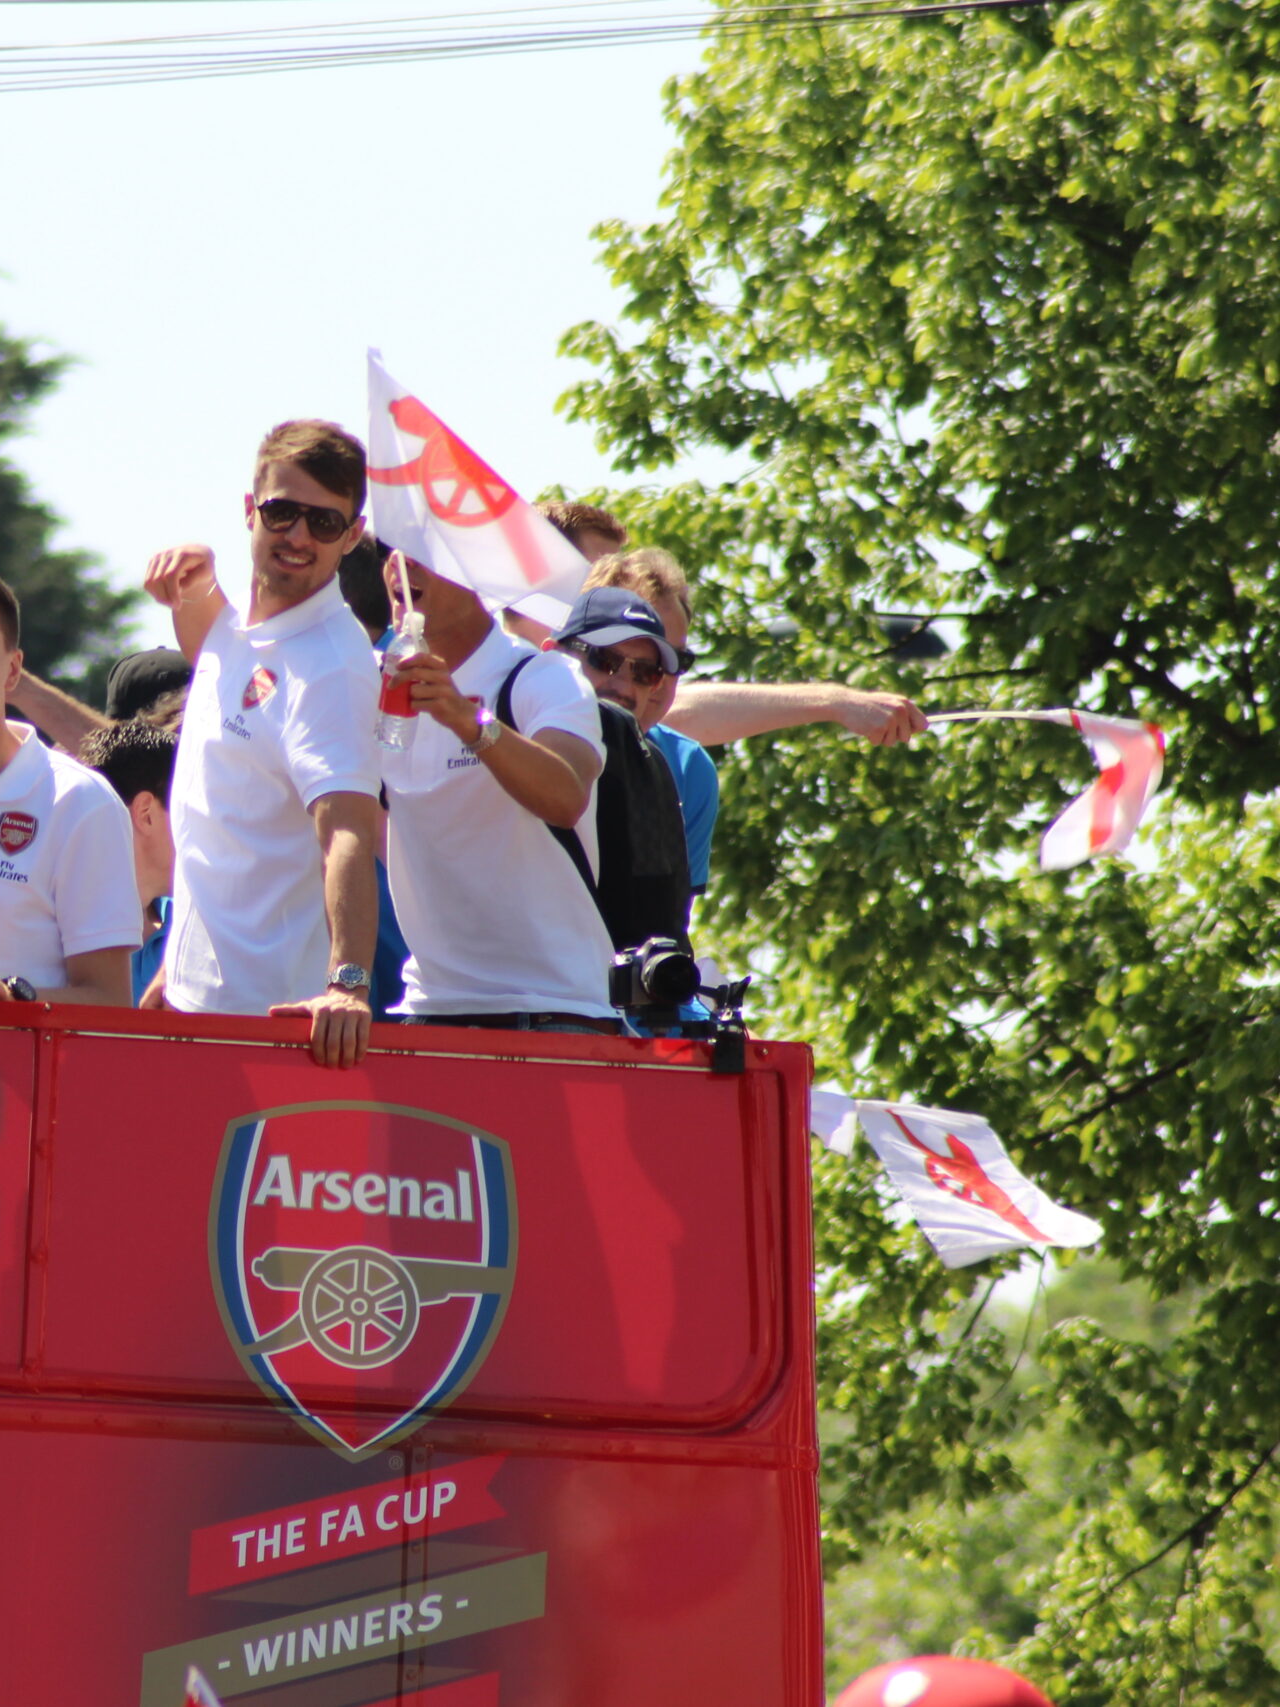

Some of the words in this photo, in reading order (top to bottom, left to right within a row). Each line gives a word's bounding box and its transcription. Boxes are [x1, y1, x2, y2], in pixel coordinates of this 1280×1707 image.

[223, 717, 252, 740] Emirates
[3, 816, 34, 829] Arsenal
[0, 860, 15, 871] Fly
[251, 1153, 475, 1223] Arsenal
[231, 1517, 306, 1568] THE
[320, 1505, 365, 1547] FA
[376, 1481, 457, 1531] CUP
[243, 1594, 443, 1677] WINNERS
